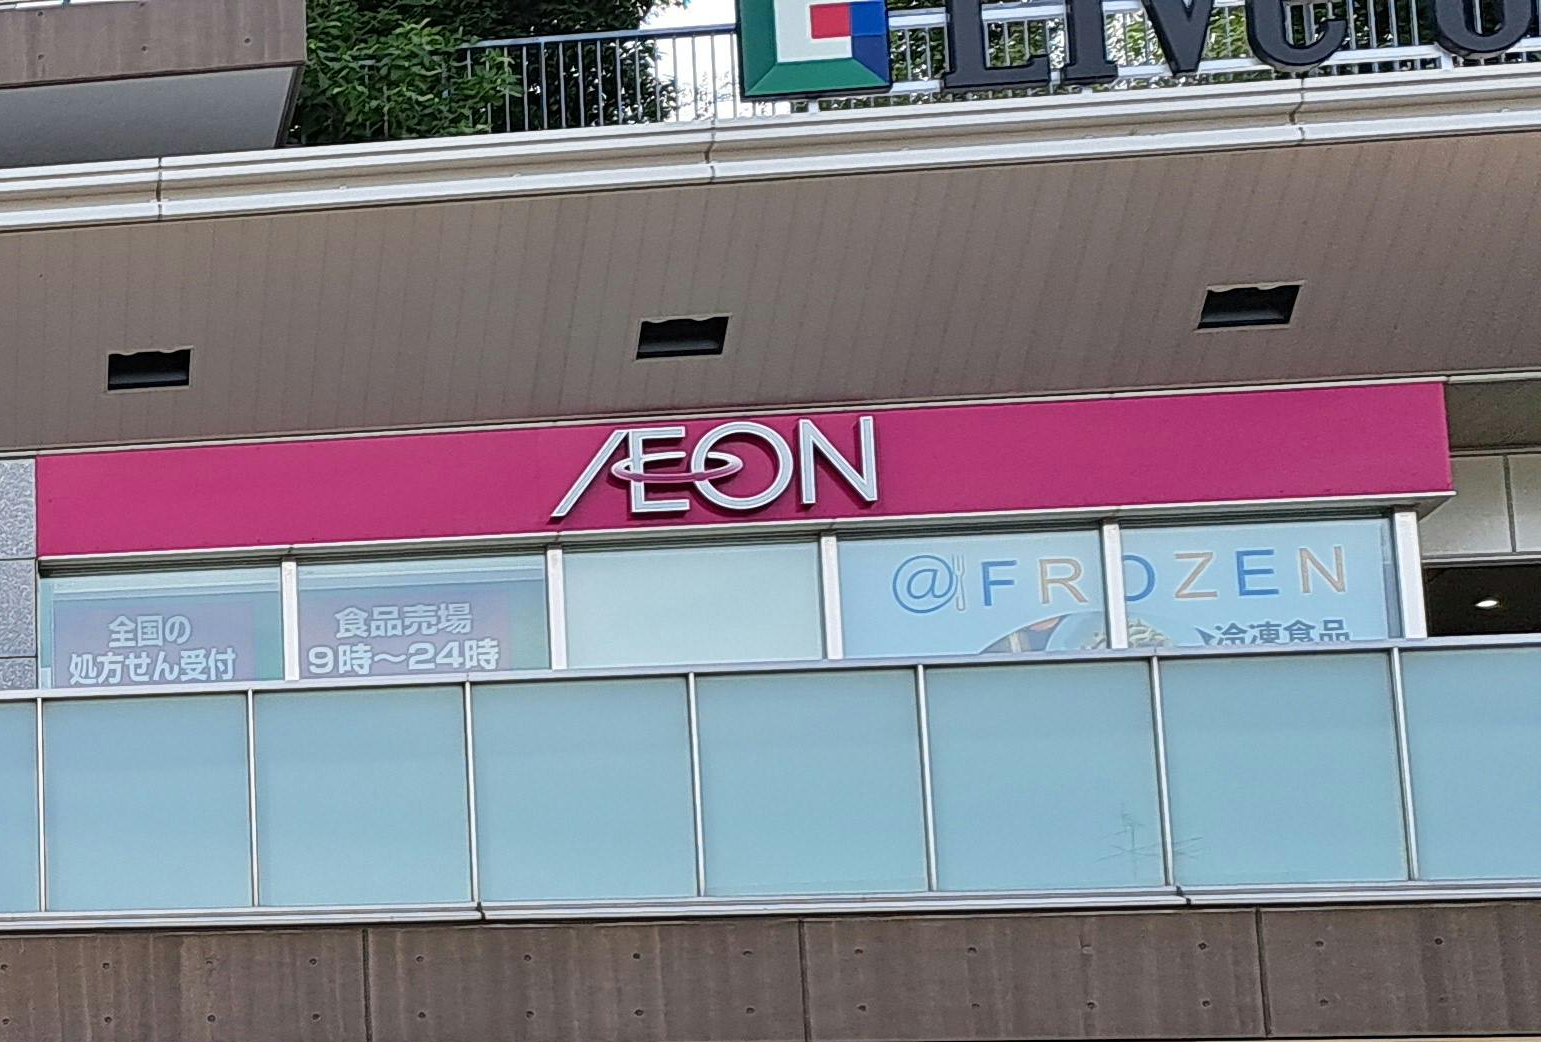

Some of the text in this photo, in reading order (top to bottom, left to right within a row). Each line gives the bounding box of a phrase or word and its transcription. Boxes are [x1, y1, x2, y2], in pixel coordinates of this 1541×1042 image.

[108, 614, 192, 648] 全国の
[335, 604, 472, 638] 食品売場
[1215, 619, 1350, 645] 冷凍食品
[69, 648, 236, 684] 処方せん受付
